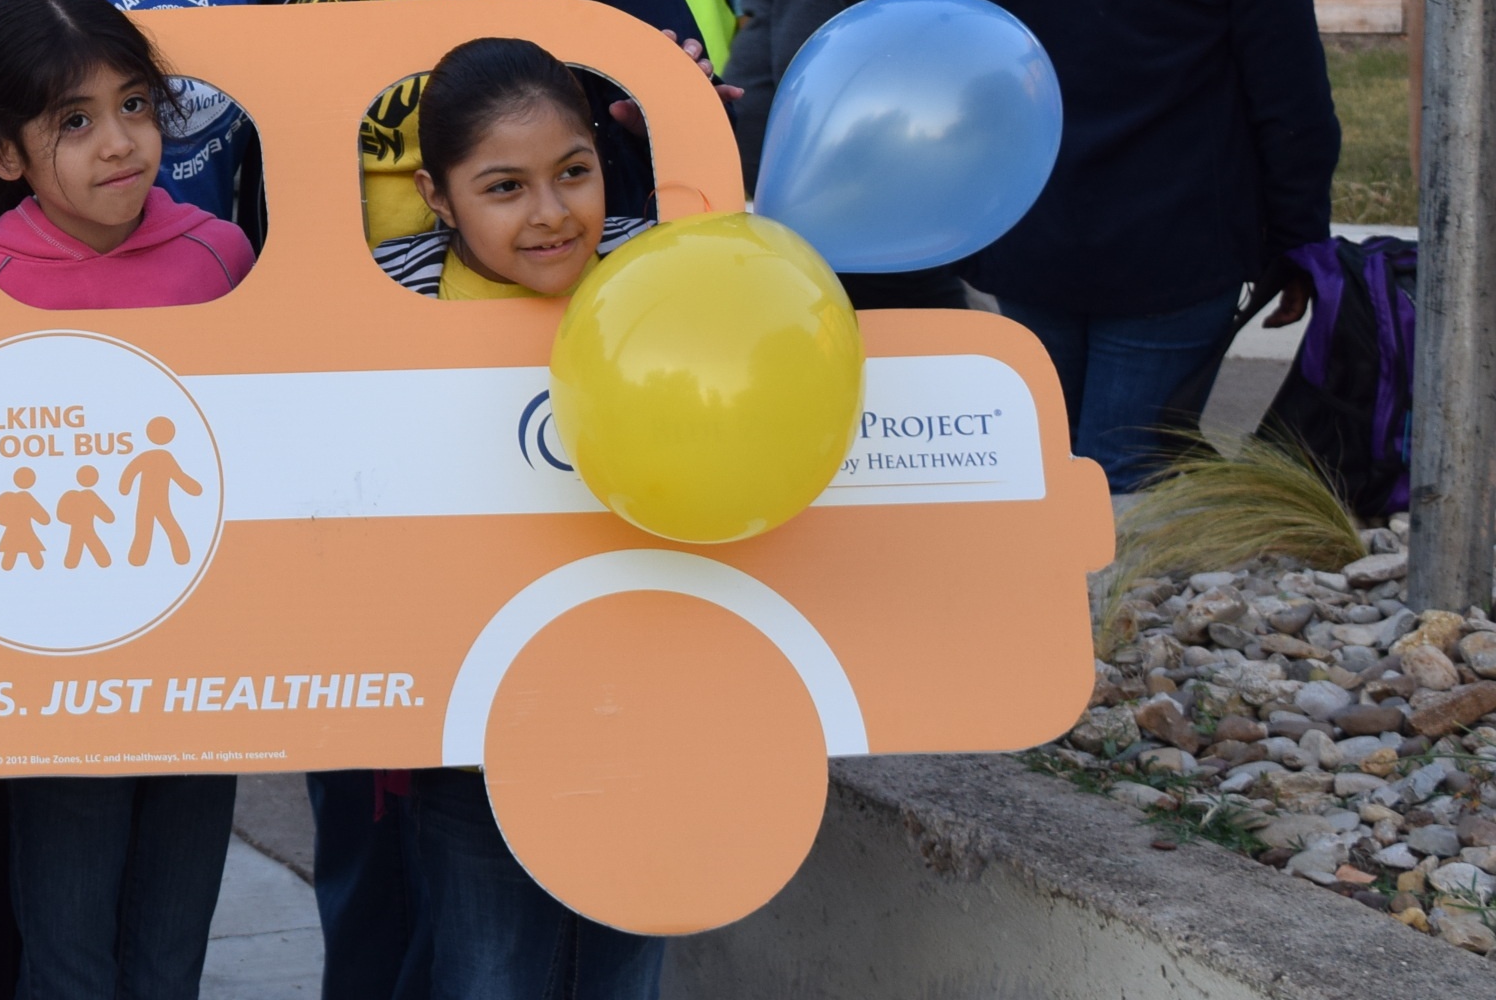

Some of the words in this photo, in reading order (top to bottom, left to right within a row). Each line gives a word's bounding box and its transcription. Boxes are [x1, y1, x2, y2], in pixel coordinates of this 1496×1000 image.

[172, 137, 223, 181] EASIER
[74, 432, 134, 456] BUS
[40, 679, 153, 716] JUST
[164, 673, 424, 712] HEALTHIER.
[5, 756, 28, 765] 2012
[30, 755, 51, 764] Blue
[53, 755, 83, 765] Zones,
[85, 754, 101, 763] LLC
[103, 753, 121, 763] and
[182, 752, 198, 761] Inc.
[201, 751, 214, 760] All
[216, 750, 243, 762] rights
[245, 749, 287, 760] reserved.
